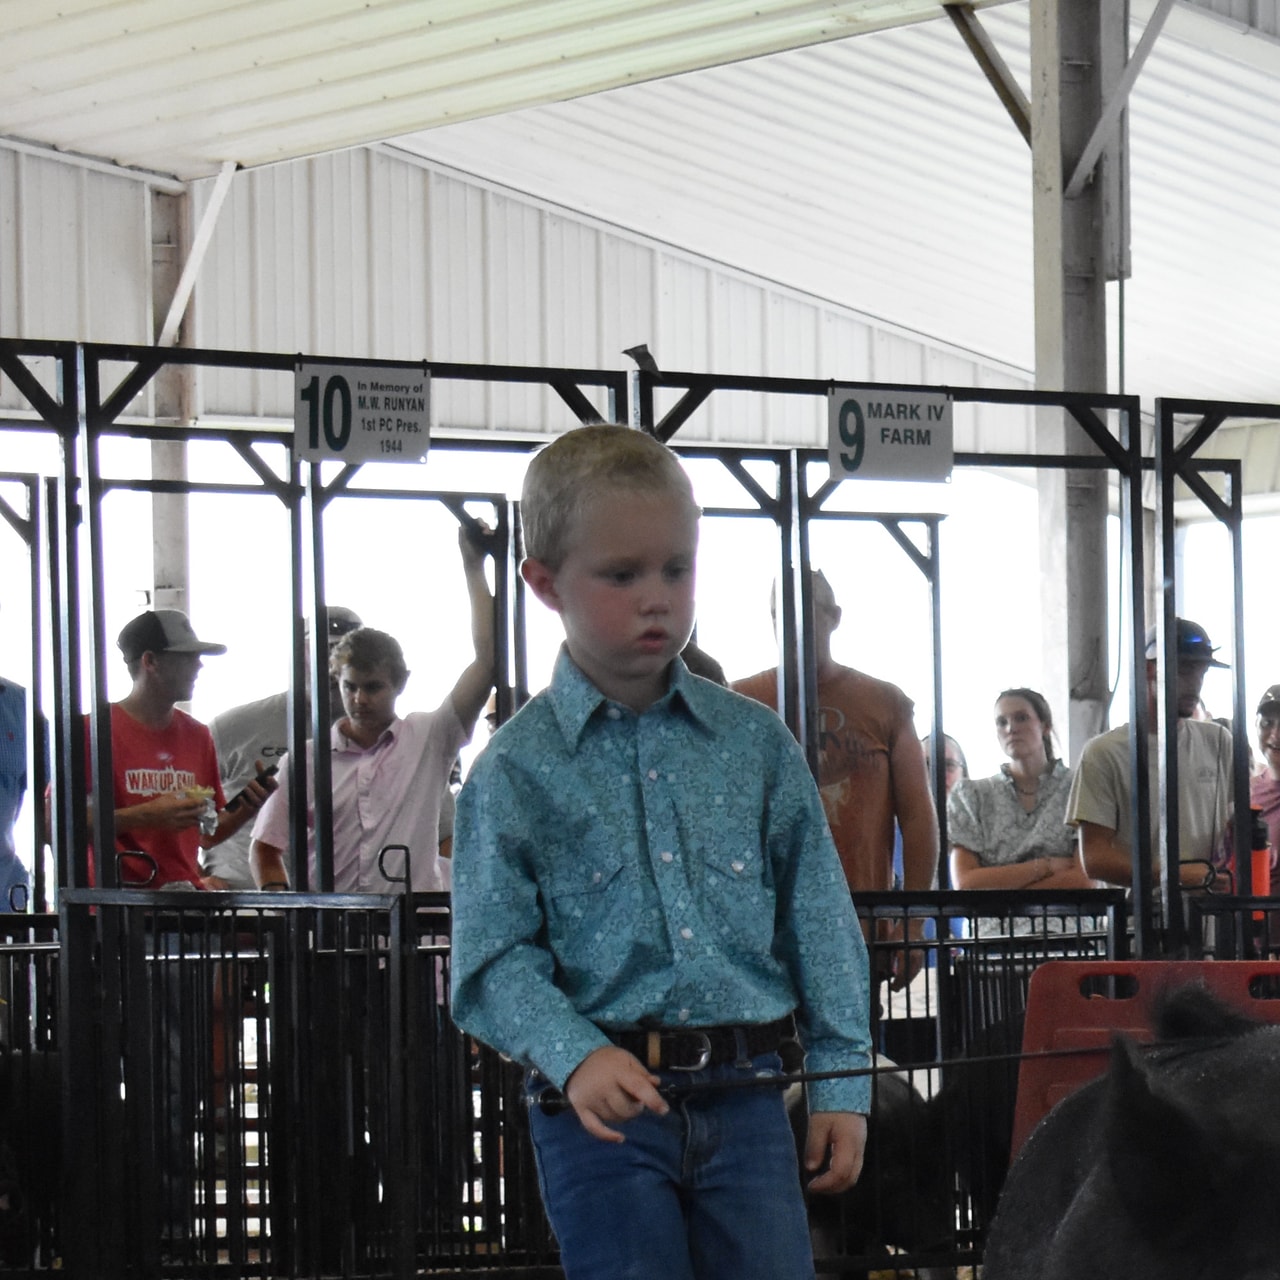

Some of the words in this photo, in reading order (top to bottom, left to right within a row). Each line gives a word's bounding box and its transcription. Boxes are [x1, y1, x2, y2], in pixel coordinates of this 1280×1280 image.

[357, 381, 367, 391] In
[370, 382, 410, 394] Memory
[412, 383, 423, 393] of
[357, 396, 381, 410] M.W.
[384, 397, 424, 412] RUNYAN
[867, 402, 921, 420] MARK
[927, 405, 944, 421] IV
[300, 374, 352, 452] 10
[361, 418, 376, 431] 1st
[379, 418, 393, 432] PC
[396, 420, 421, 433] Pres.
[839, 398, 865, 472] 9
[880, 427, 932, 446] FARM
[380, 439, 403, 453] 1944
